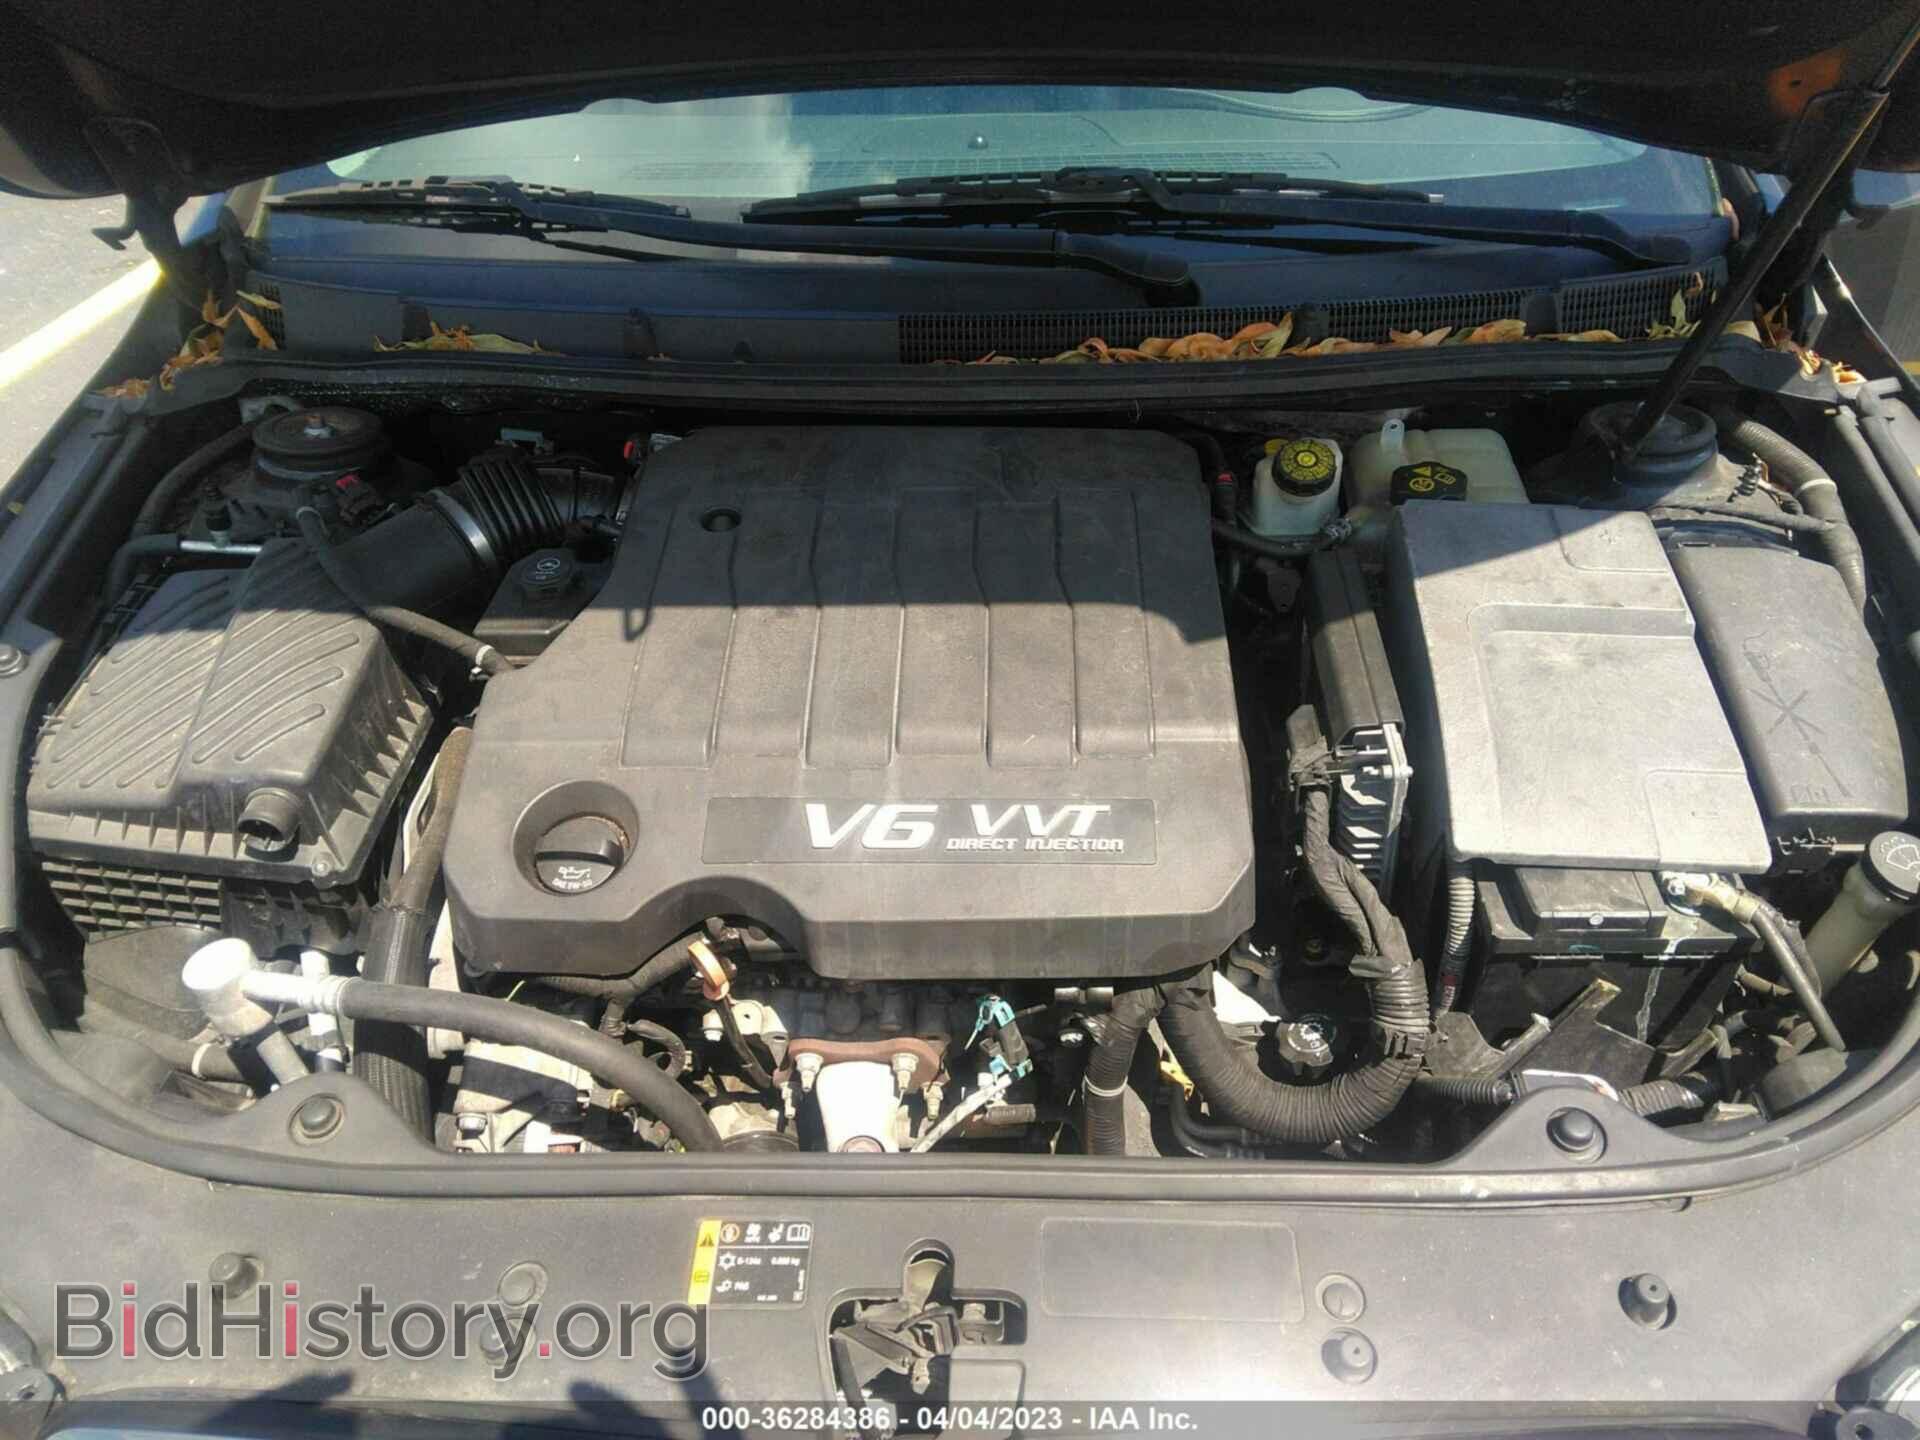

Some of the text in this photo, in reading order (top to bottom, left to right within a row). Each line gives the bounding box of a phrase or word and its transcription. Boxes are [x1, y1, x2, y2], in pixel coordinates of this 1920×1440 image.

[805, 803, 1111, 848] V6 VVT
[946, 838, 1124, 851] DIRECT INJECTION
